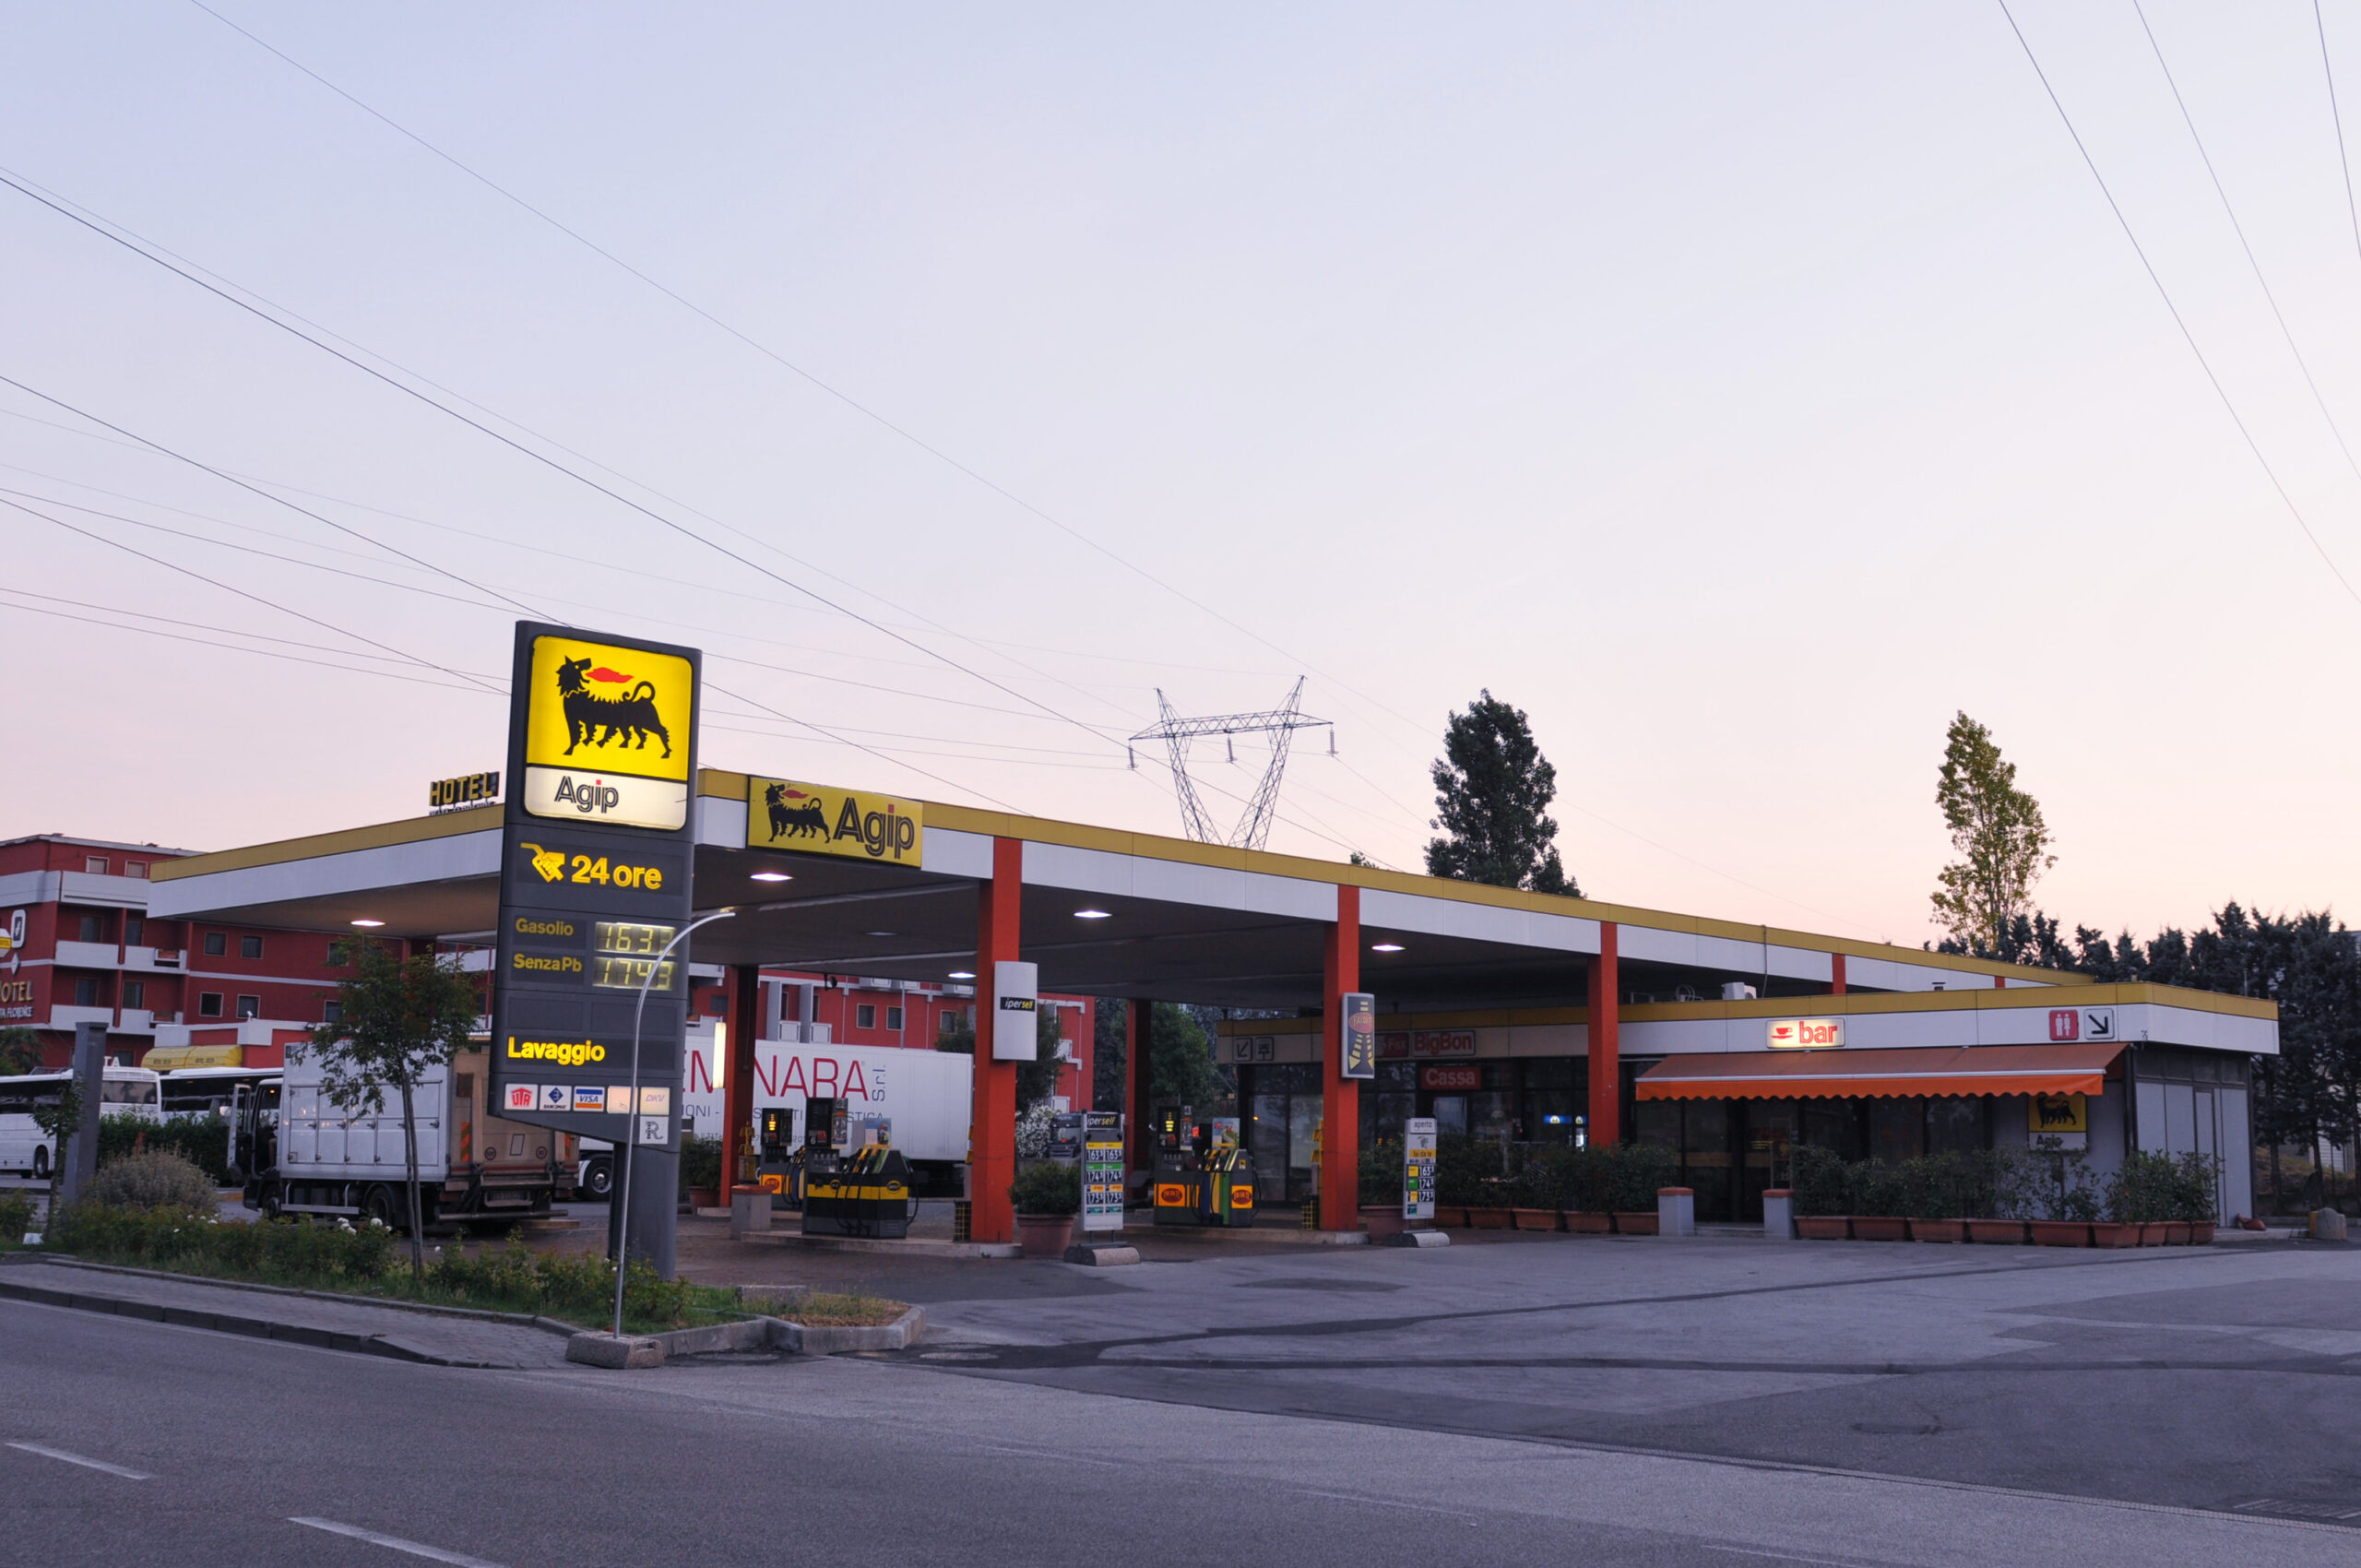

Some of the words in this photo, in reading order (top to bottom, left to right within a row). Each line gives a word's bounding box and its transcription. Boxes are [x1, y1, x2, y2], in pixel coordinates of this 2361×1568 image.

[429, 772, 495, 806] HOTEL
[554, 776, 619, 814] Agip
[833, 797, 915, 860] Agip
[571, 854, 610, 885] 24
[612, 864, 663, 890] ore
[516, 918, 575, 936] Gasolio
[514, 953, 560, 971] Senza
[562, 956, 583, 972] Pb
[1, 980, 33, 1003] OTEL
[1799, 1021, 1838, 1043] bar
[507, 1037, 606, 1066] Lavaggio
[1414, 1032, 1472, 1055] BigBon
[1426, 1068, 1476, 1086] Cassa
[510, 1087, 533, 1107] UTA
[579, 1094, 599, 1103] VISA
[646, 1094, 666, 1103] DKV
